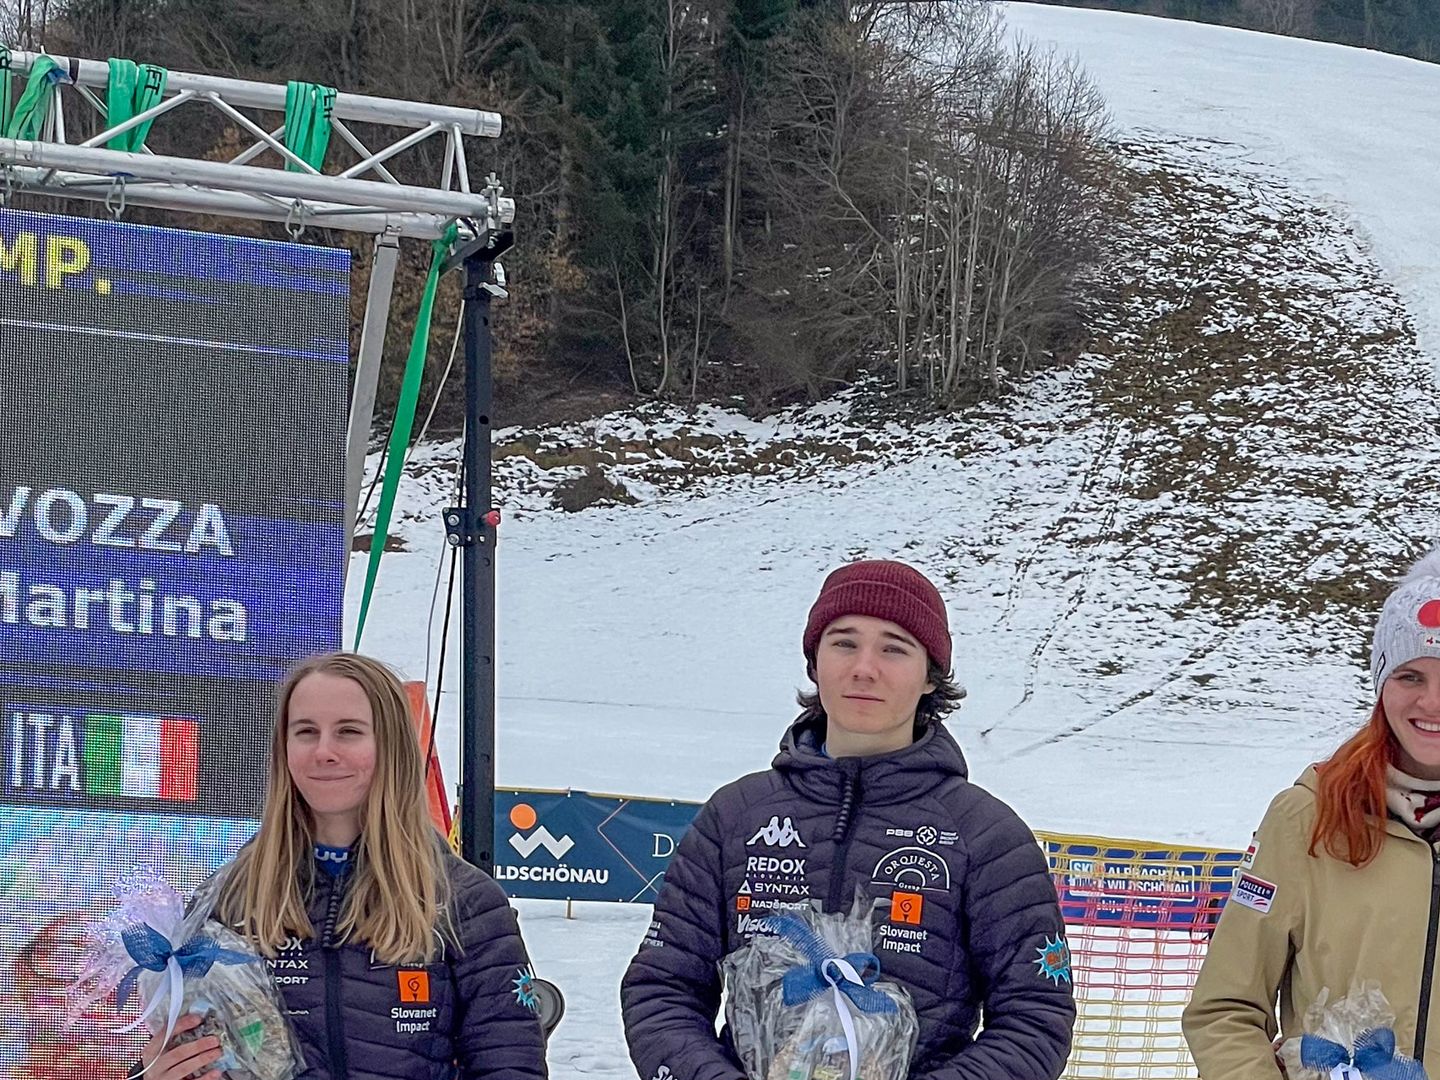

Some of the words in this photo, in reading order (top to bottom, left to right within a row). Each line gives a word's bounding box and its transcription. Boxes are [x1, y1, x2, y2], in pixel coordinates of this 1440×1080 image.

[11, 713, 80, 791] ITA
[746, 856, 806, 876] REDOX
[884, 855, 940, 881] ORQUESTA
[754, 882, 810, 896] SYNTAX
[1240, 880, 1266, 896] POLIZEI
[879, 924, 928, 941] Slovanet
[882, 938, 921, 954] Impact
[391, 1006, 437, 1019] Slovanet
[396, 1020, 431, 1034] Impact
